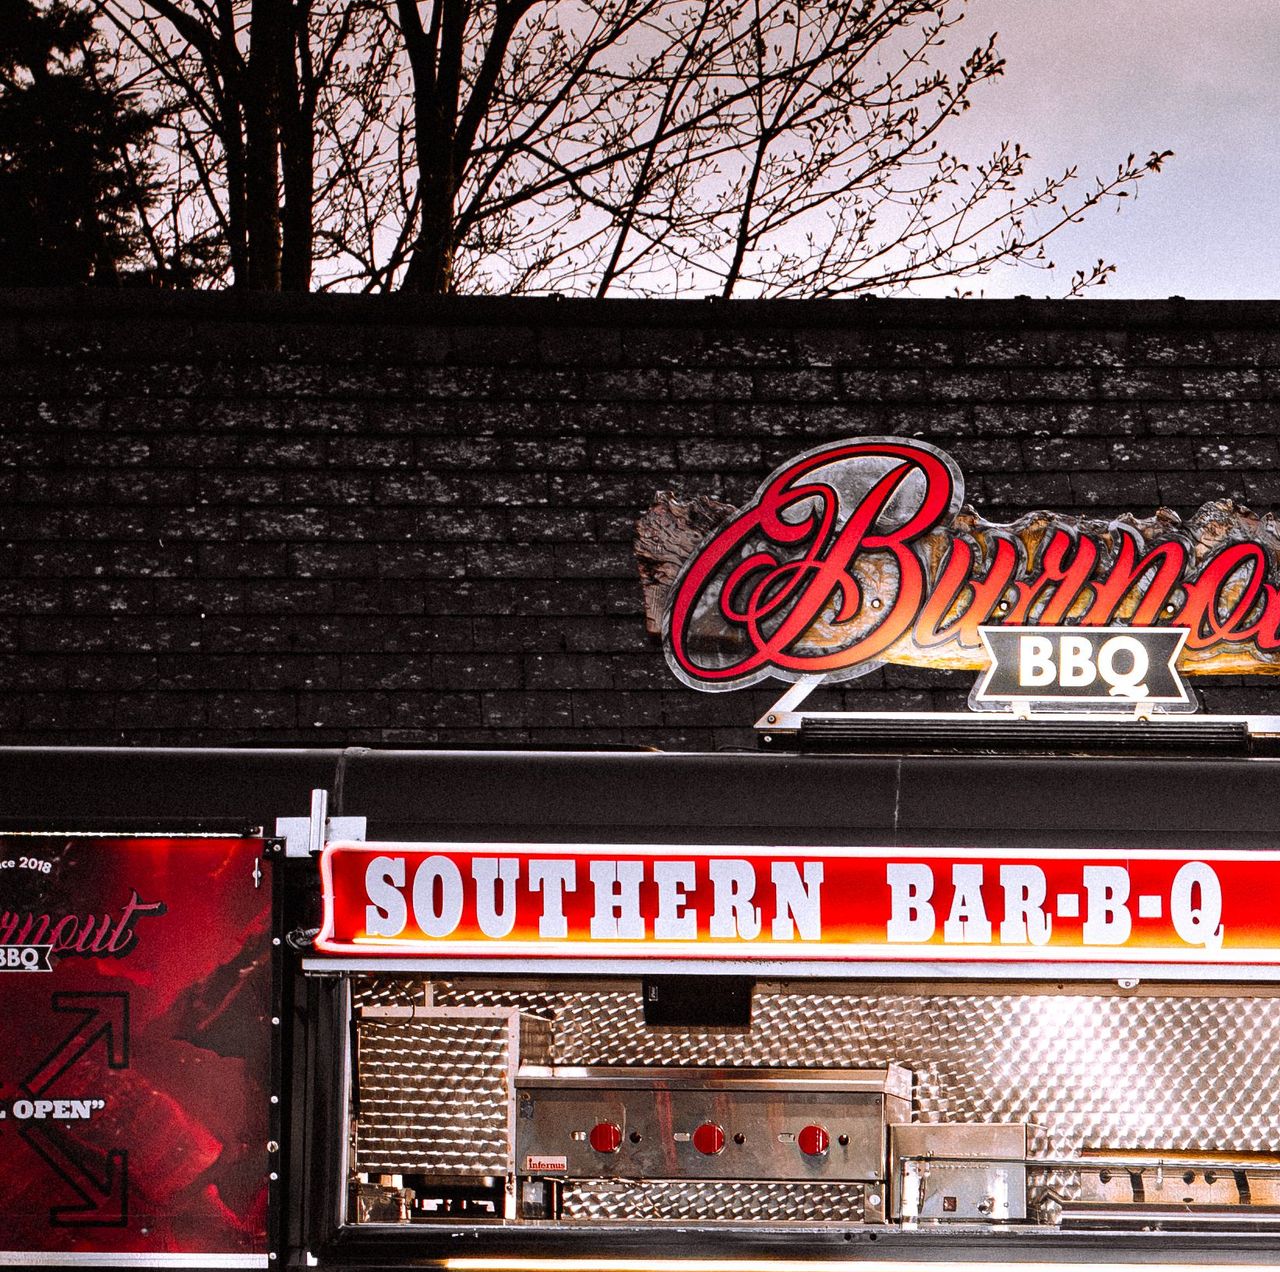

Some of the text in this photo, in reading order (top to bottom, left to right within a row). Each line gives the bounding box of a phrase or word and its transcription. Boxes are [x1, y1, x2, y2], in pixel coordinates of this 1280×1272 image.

[1018, 637, 1151, 698] BBQ
[19, 856, 52, 874] 2018
[363, 855, 825, 943] SOUTHERN
[886, 861, 1224, 952] BAR-B-Q
